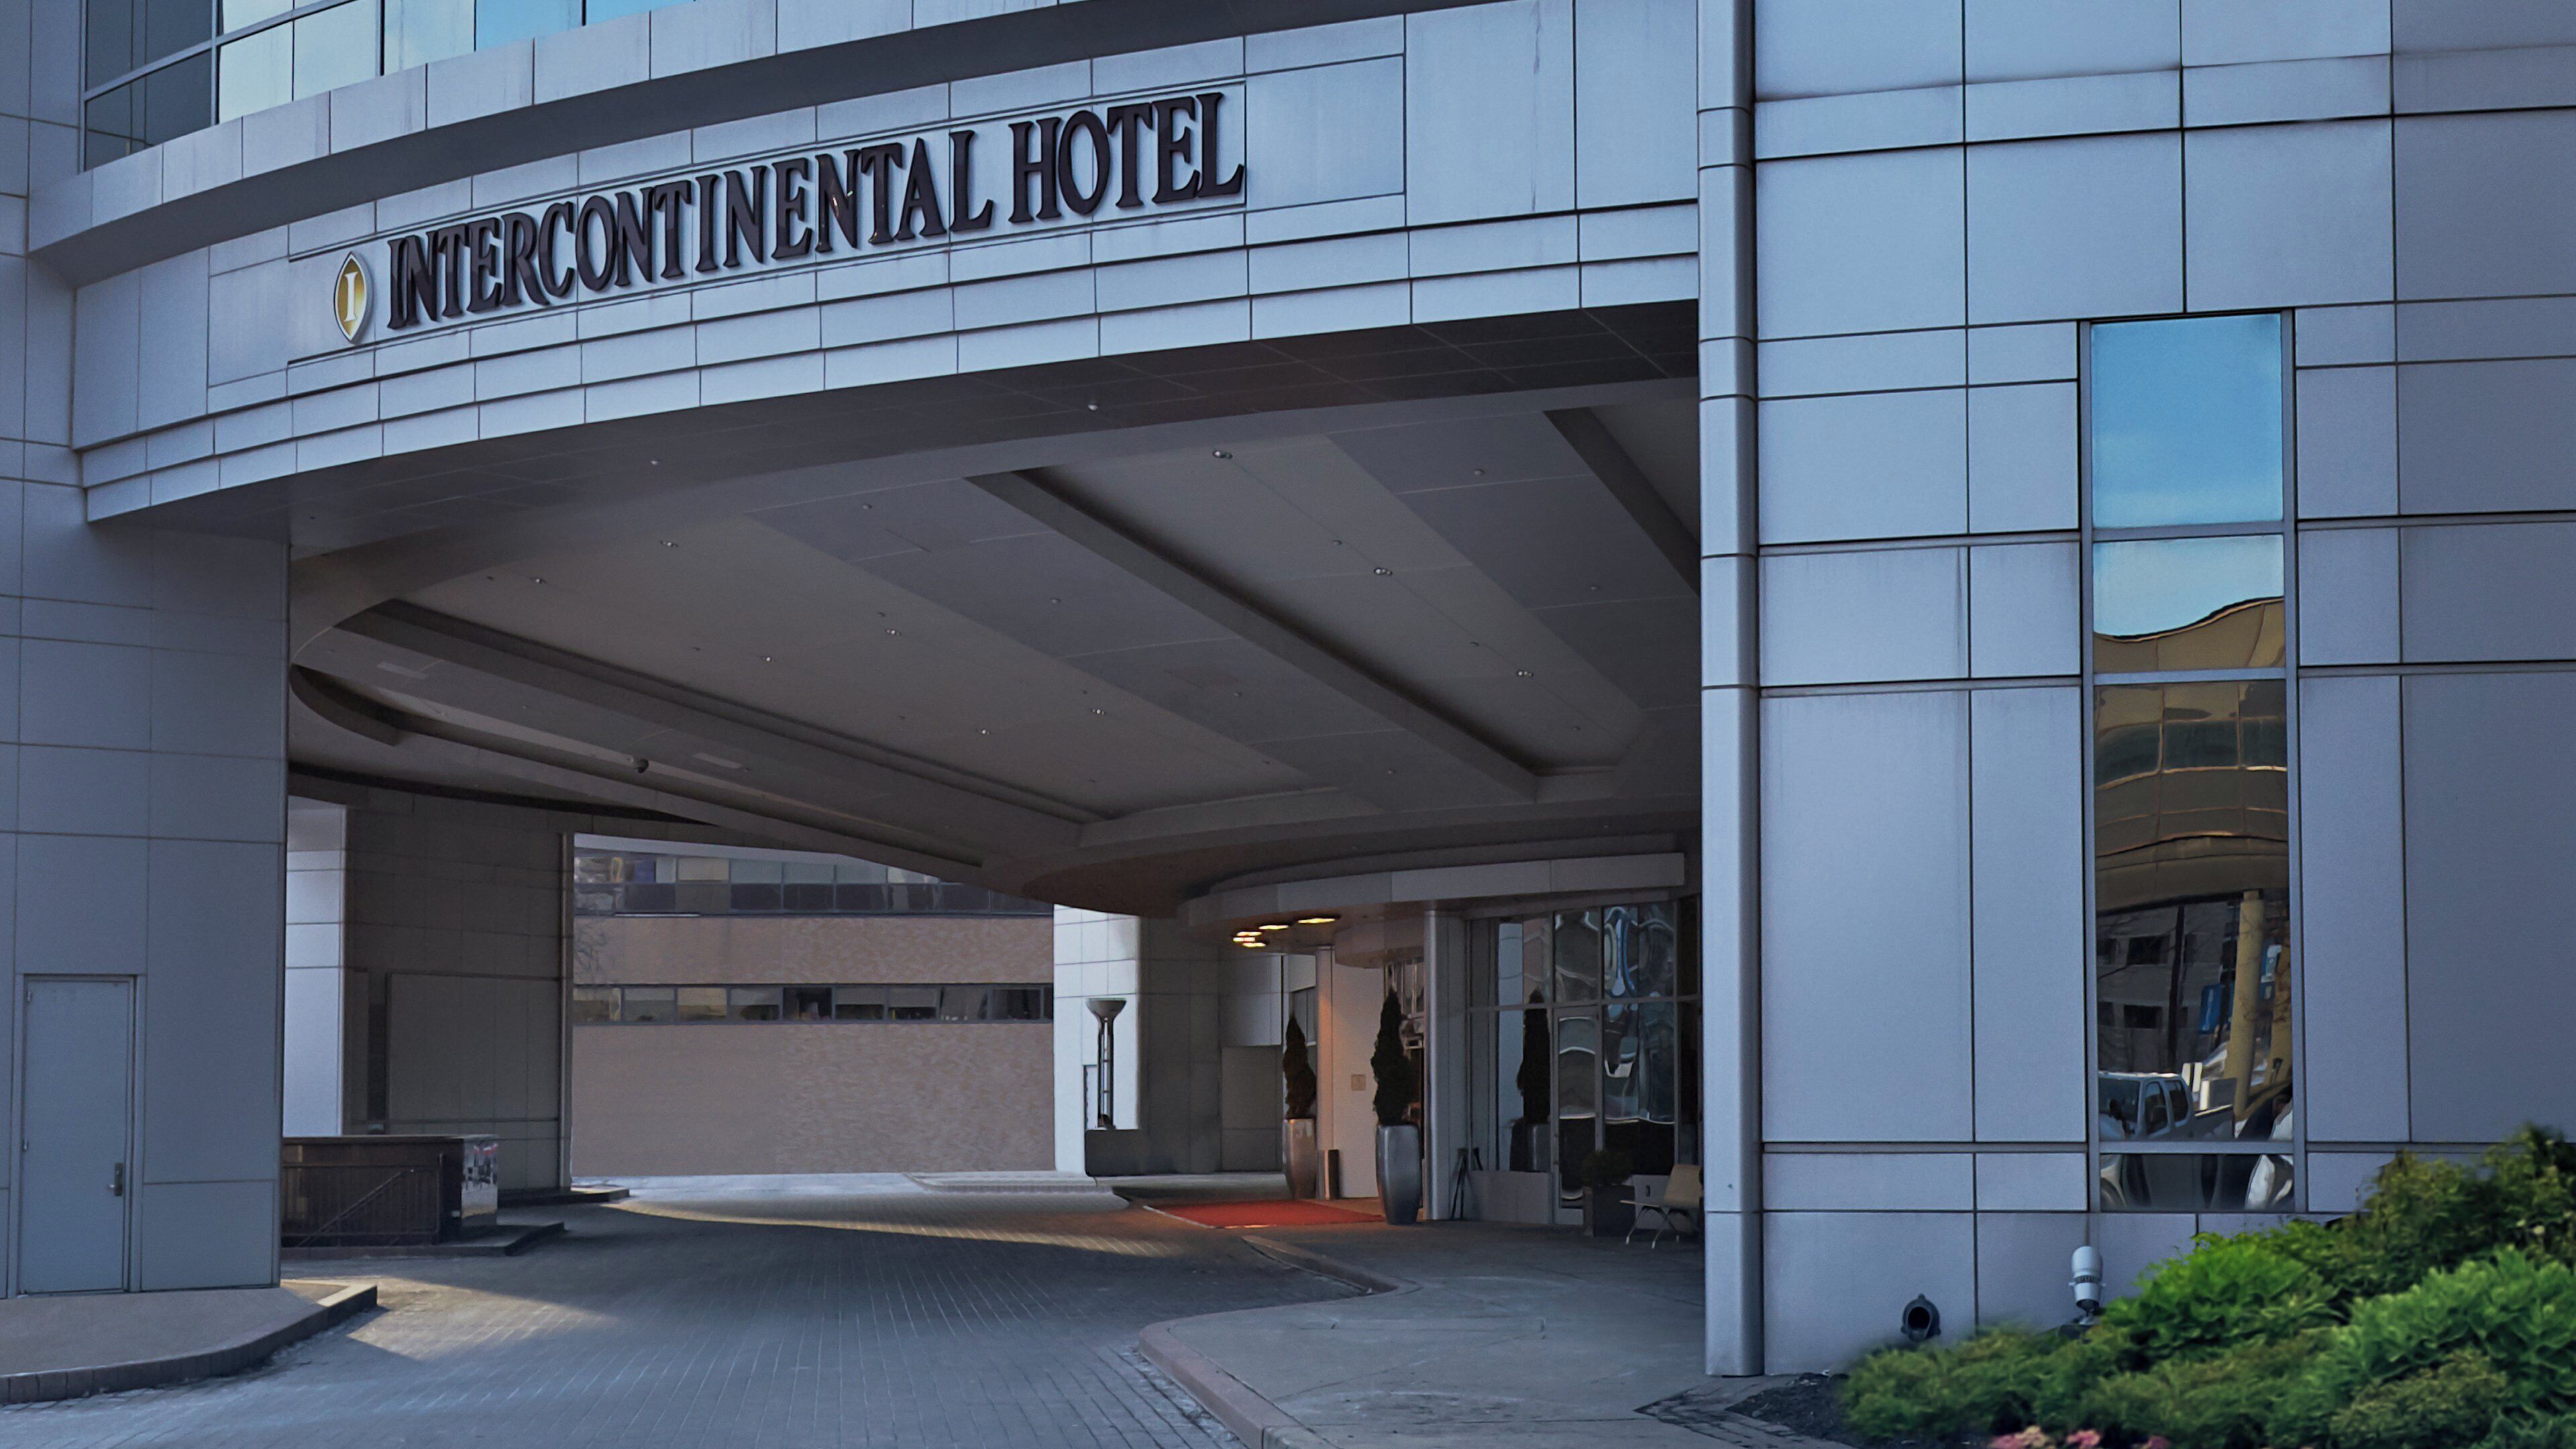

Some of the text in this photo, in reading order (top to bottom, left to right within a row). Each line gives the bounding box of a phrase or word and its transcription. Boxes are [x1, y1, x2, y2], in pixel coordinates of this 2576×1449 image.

[387, 92, 1244, 329] INTERCONTINENTAL HOTEL
[343, 271, 358, 323] I
